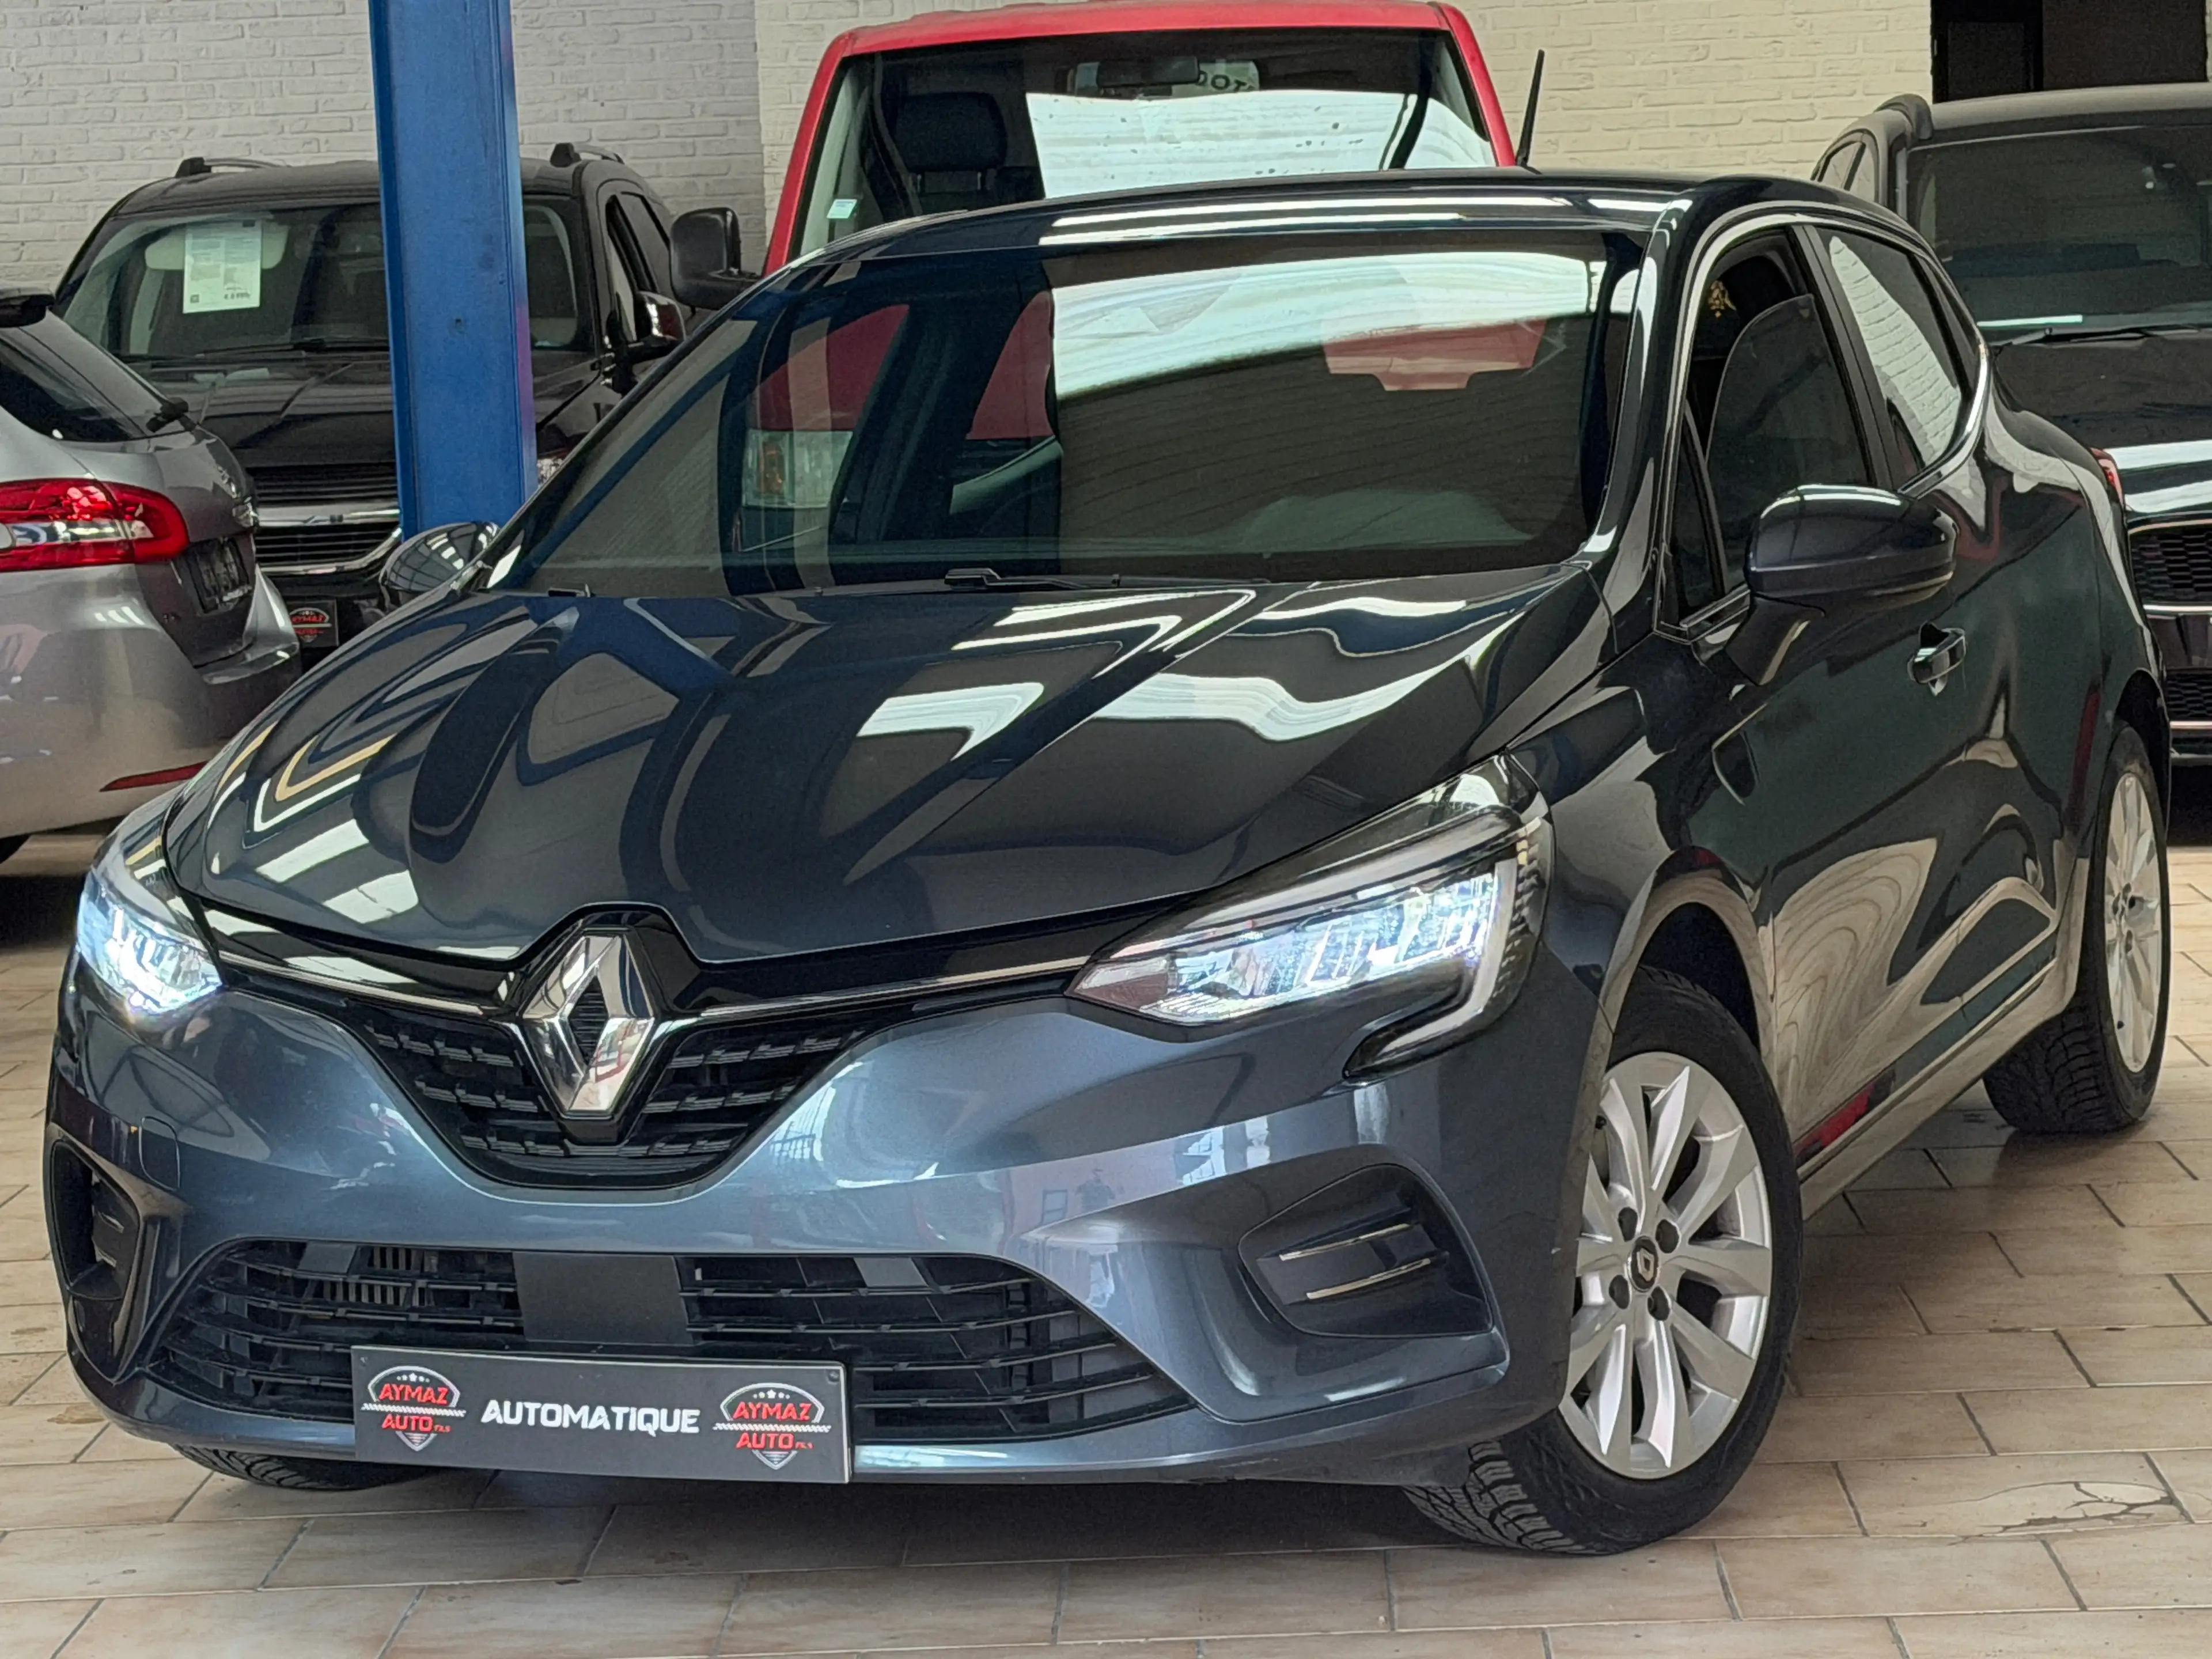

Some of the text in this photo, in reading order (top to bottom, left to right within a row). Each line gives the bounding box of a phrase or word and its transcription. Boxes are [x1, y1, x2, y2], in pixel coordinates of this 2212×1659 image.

[379, 1384, 448, 1405] AYMAZ
[480, 1400, 700, 1437] AUTOMATIQUE
[733, 1401, 812, 1421] AYMAZ
[382, 1414, 433, 1432] AUTO
[736, 1433, 794, 1449] AUTO
